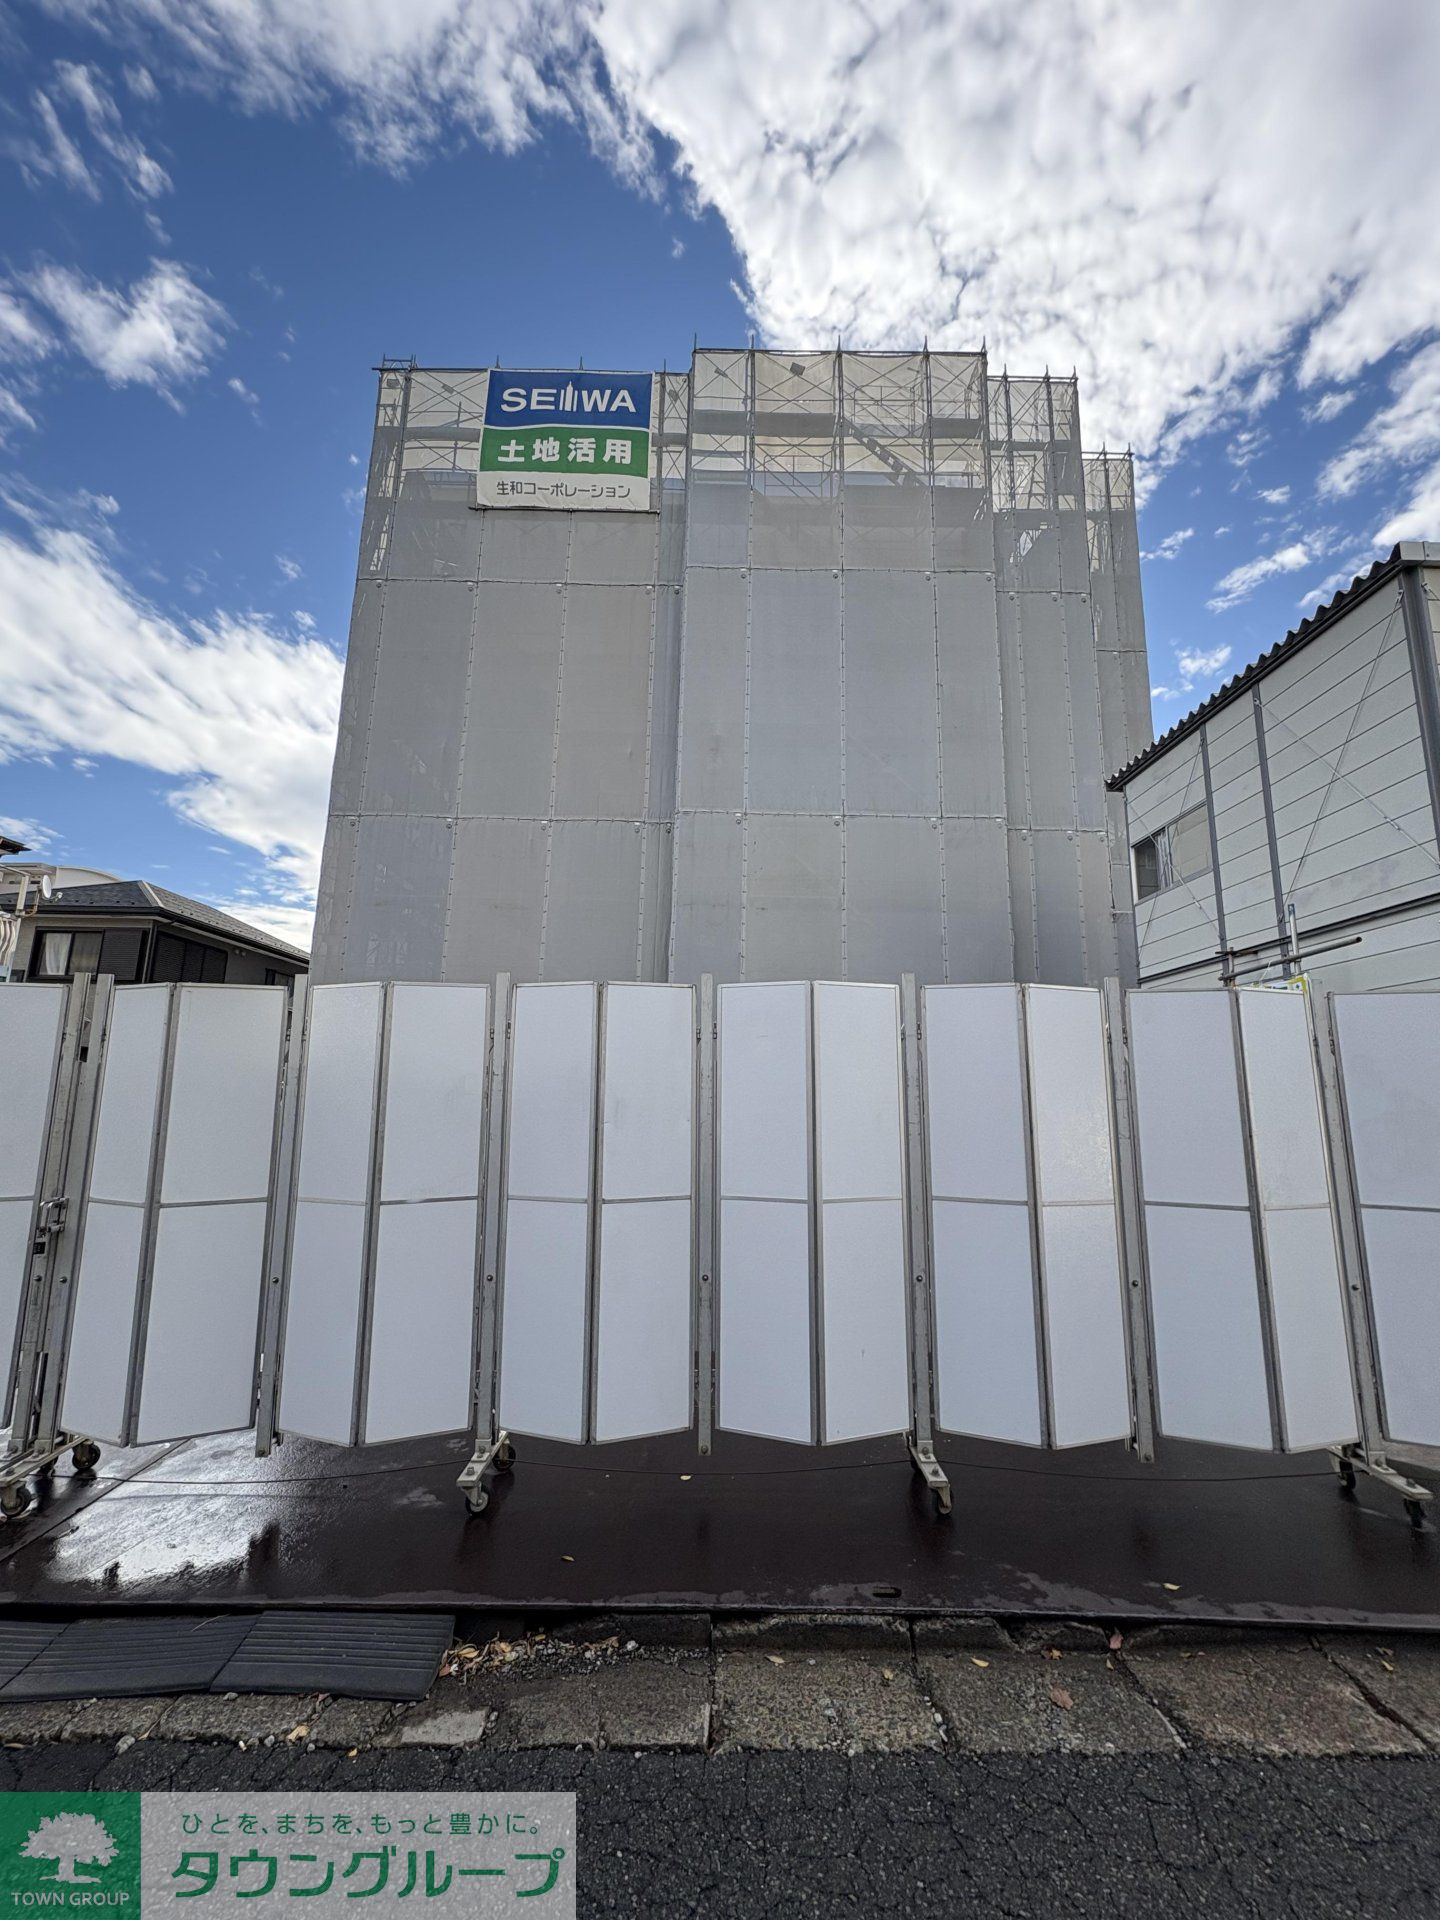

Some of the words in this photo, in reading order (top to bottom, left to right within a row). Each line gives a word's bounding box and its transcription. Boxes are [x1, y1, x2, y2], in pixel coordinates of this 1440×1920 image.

[498, 437, 632, 465] 土地活用
[496, 481, 631, 498] 生和コーポレーション
